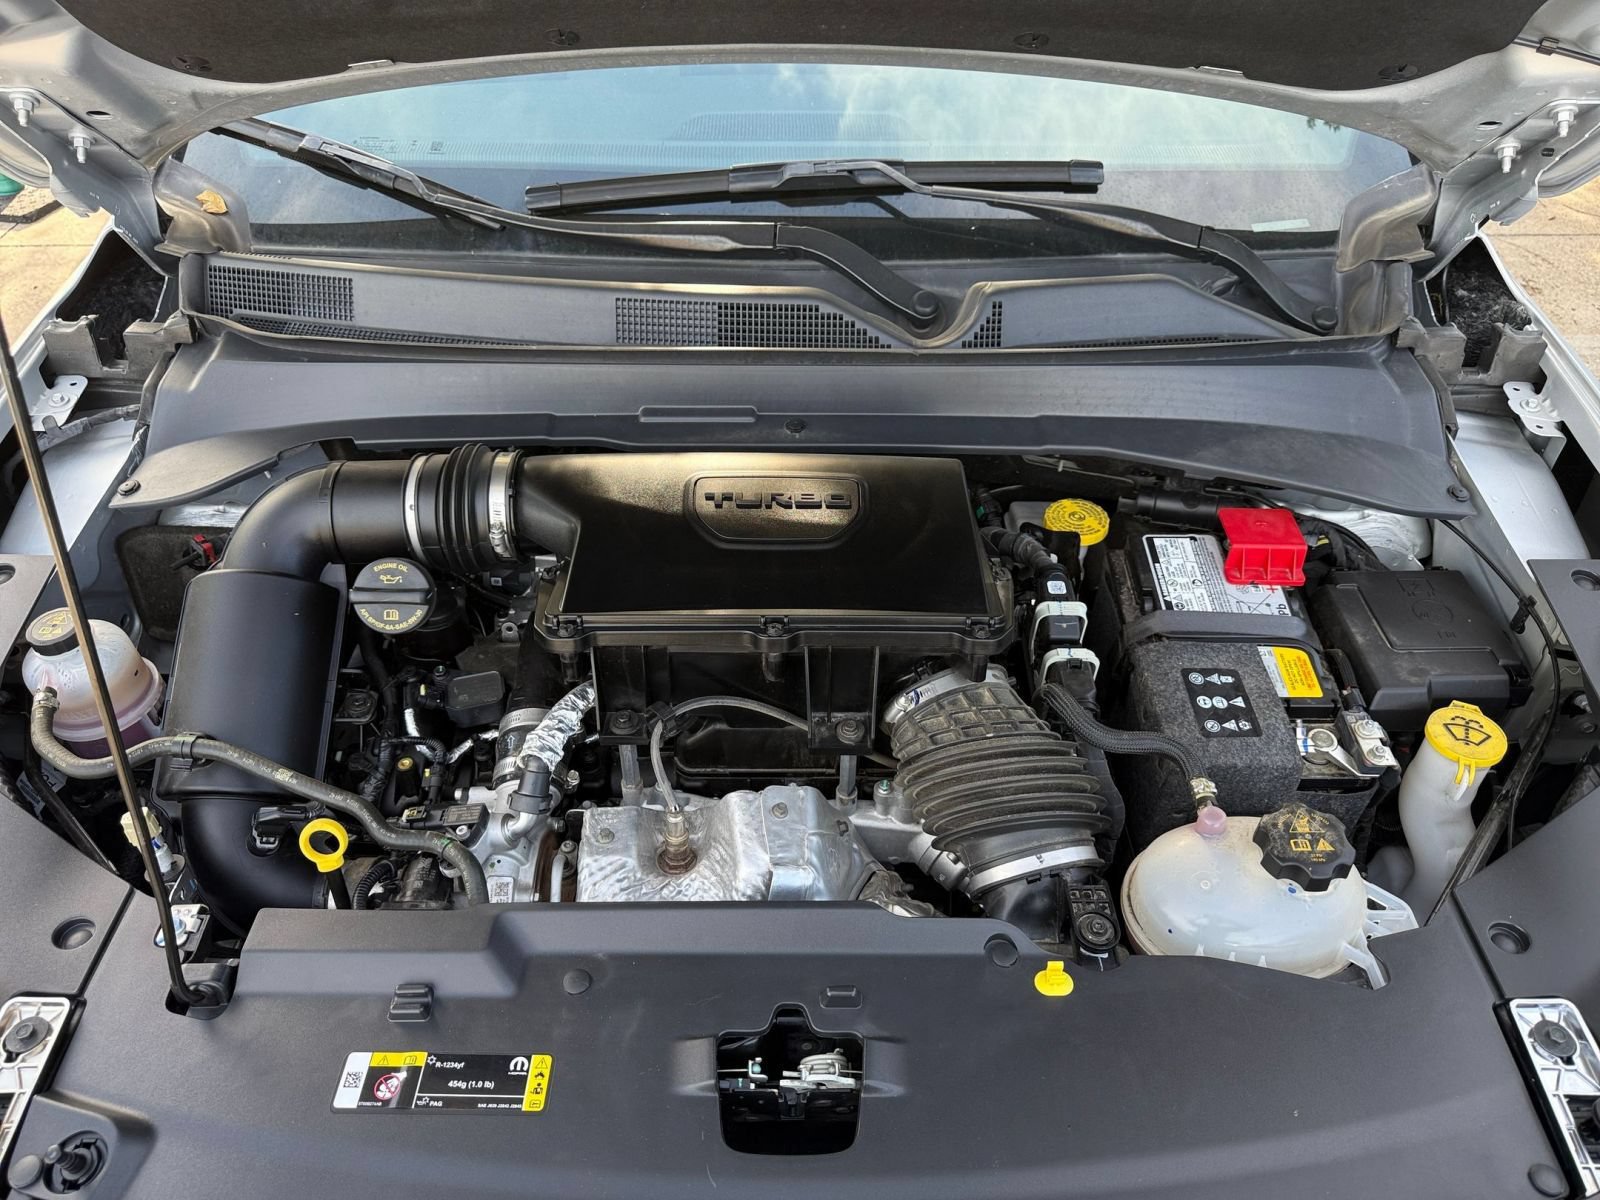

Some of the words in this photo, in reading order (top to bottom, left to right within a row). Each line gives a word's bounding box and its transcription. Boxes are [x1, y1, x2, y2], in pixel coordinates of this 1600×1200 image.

[704, 492, 852, 510] TURBO
[373, 562, 398, 572] ENGINE
[398, 563, 409, 573] OIL
[360, 608, 369, 619] API
[1276, 603, 1287, 616] Pb
[435, 1061, 465, 1070] R-1234yf
[448, 1080, 467, 1090] 454g
[468, 1080, 483, 1089] (1.0
[483, 1080, 495, 1090] lb)
